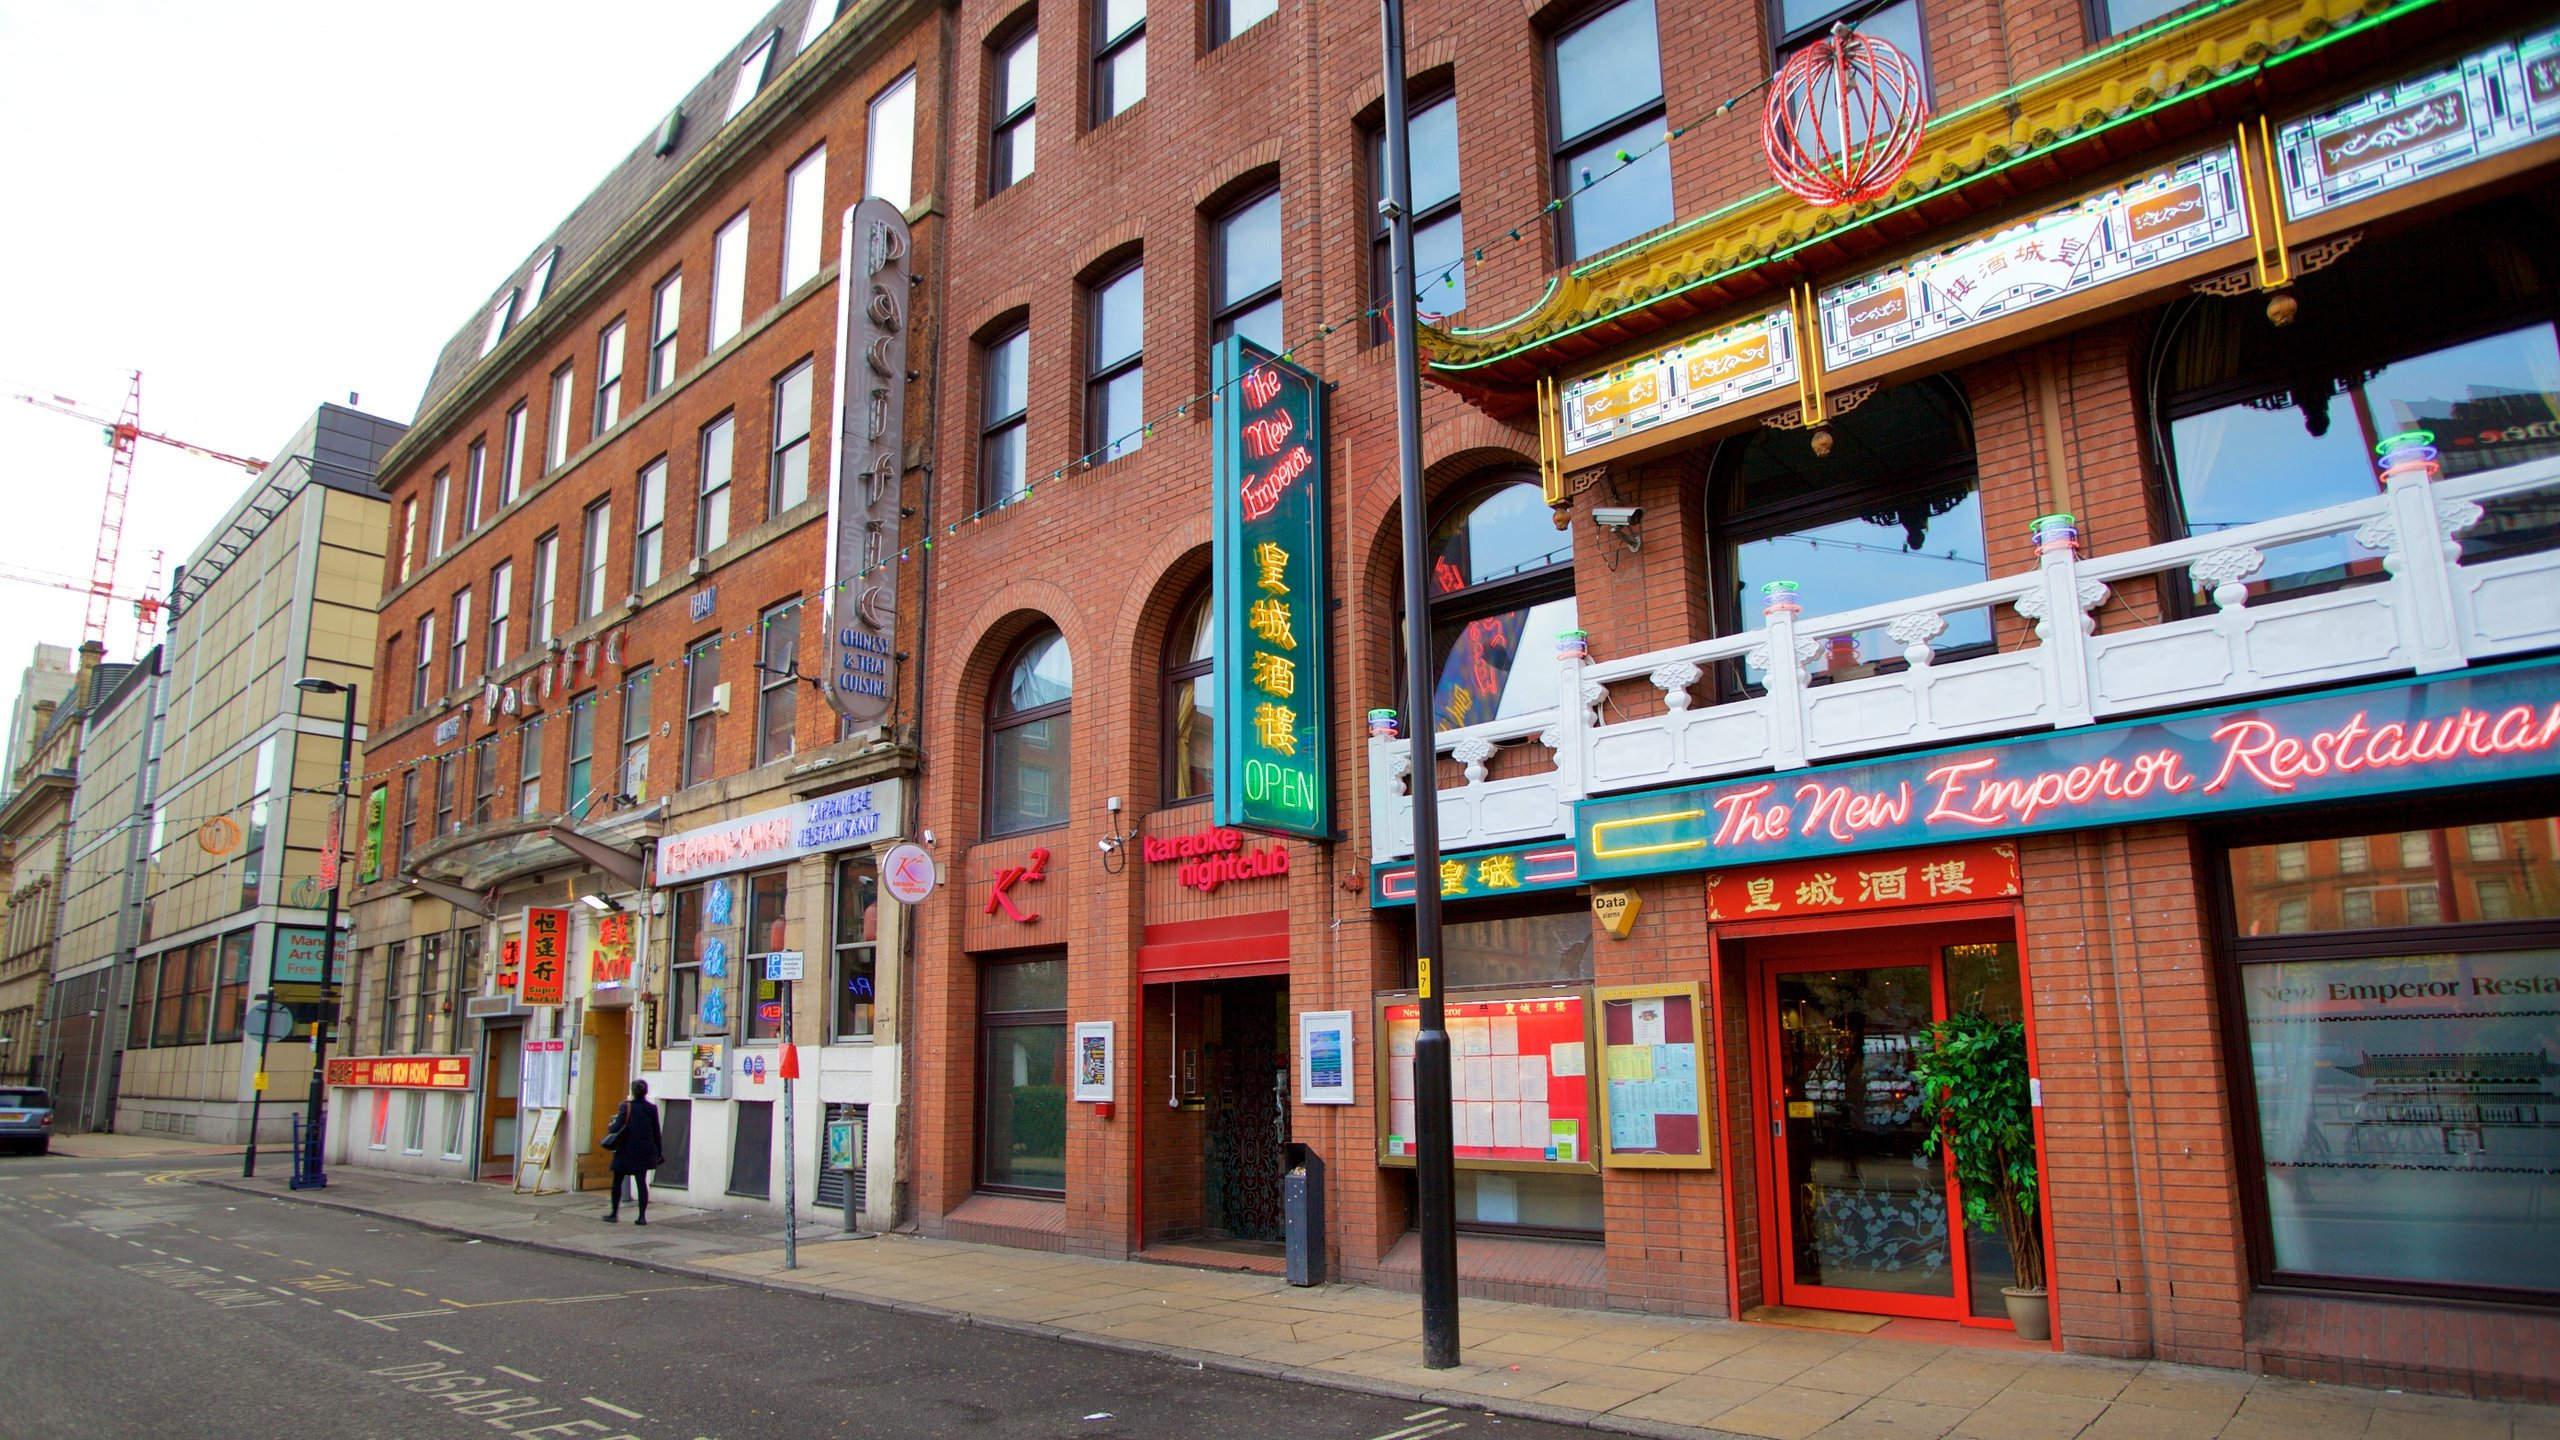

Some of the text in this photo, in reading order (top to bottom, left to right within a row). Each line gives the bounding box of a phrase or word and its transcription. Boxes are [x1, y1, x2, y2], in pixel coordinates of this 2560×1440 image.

[1242, 364, 1281, 411] The
[1242, 408, 1293, 459] New
[1241, 446, 1312, 522] Emperor
[841, 628, 890, 655] CHINESE
[844, 652, 885, 676] & THAI
[840, 672, 888, 698] CUISINE
[1245, 759, 1314, 811] OPEN
[1713, 784, 1790, 848] The
[1795, 779, 1911, 842] New
[1924, 748, 2195, 824] Emperor
[807, 790, 873, 823] JAPANESE
[796, 812, 881, 848] RESTAURANT
[1144, 824, 1244, 863] karaoke
[1178, 845, 1290, 891] nightclub
[1744, 860, 1974, 913] 皇城酒樓
[1596, 897, 1626, 909] Data
[288, 963, 317, 974] Free
[289, 949, 312, 961] Art
[529, 986, 557, 995] Super
[2328, 980, 2460, 1004] Emperor
[1402, 1009, 1420, 1018] New
[1505, 1001, 1567, 1015] 皇城酒樓
